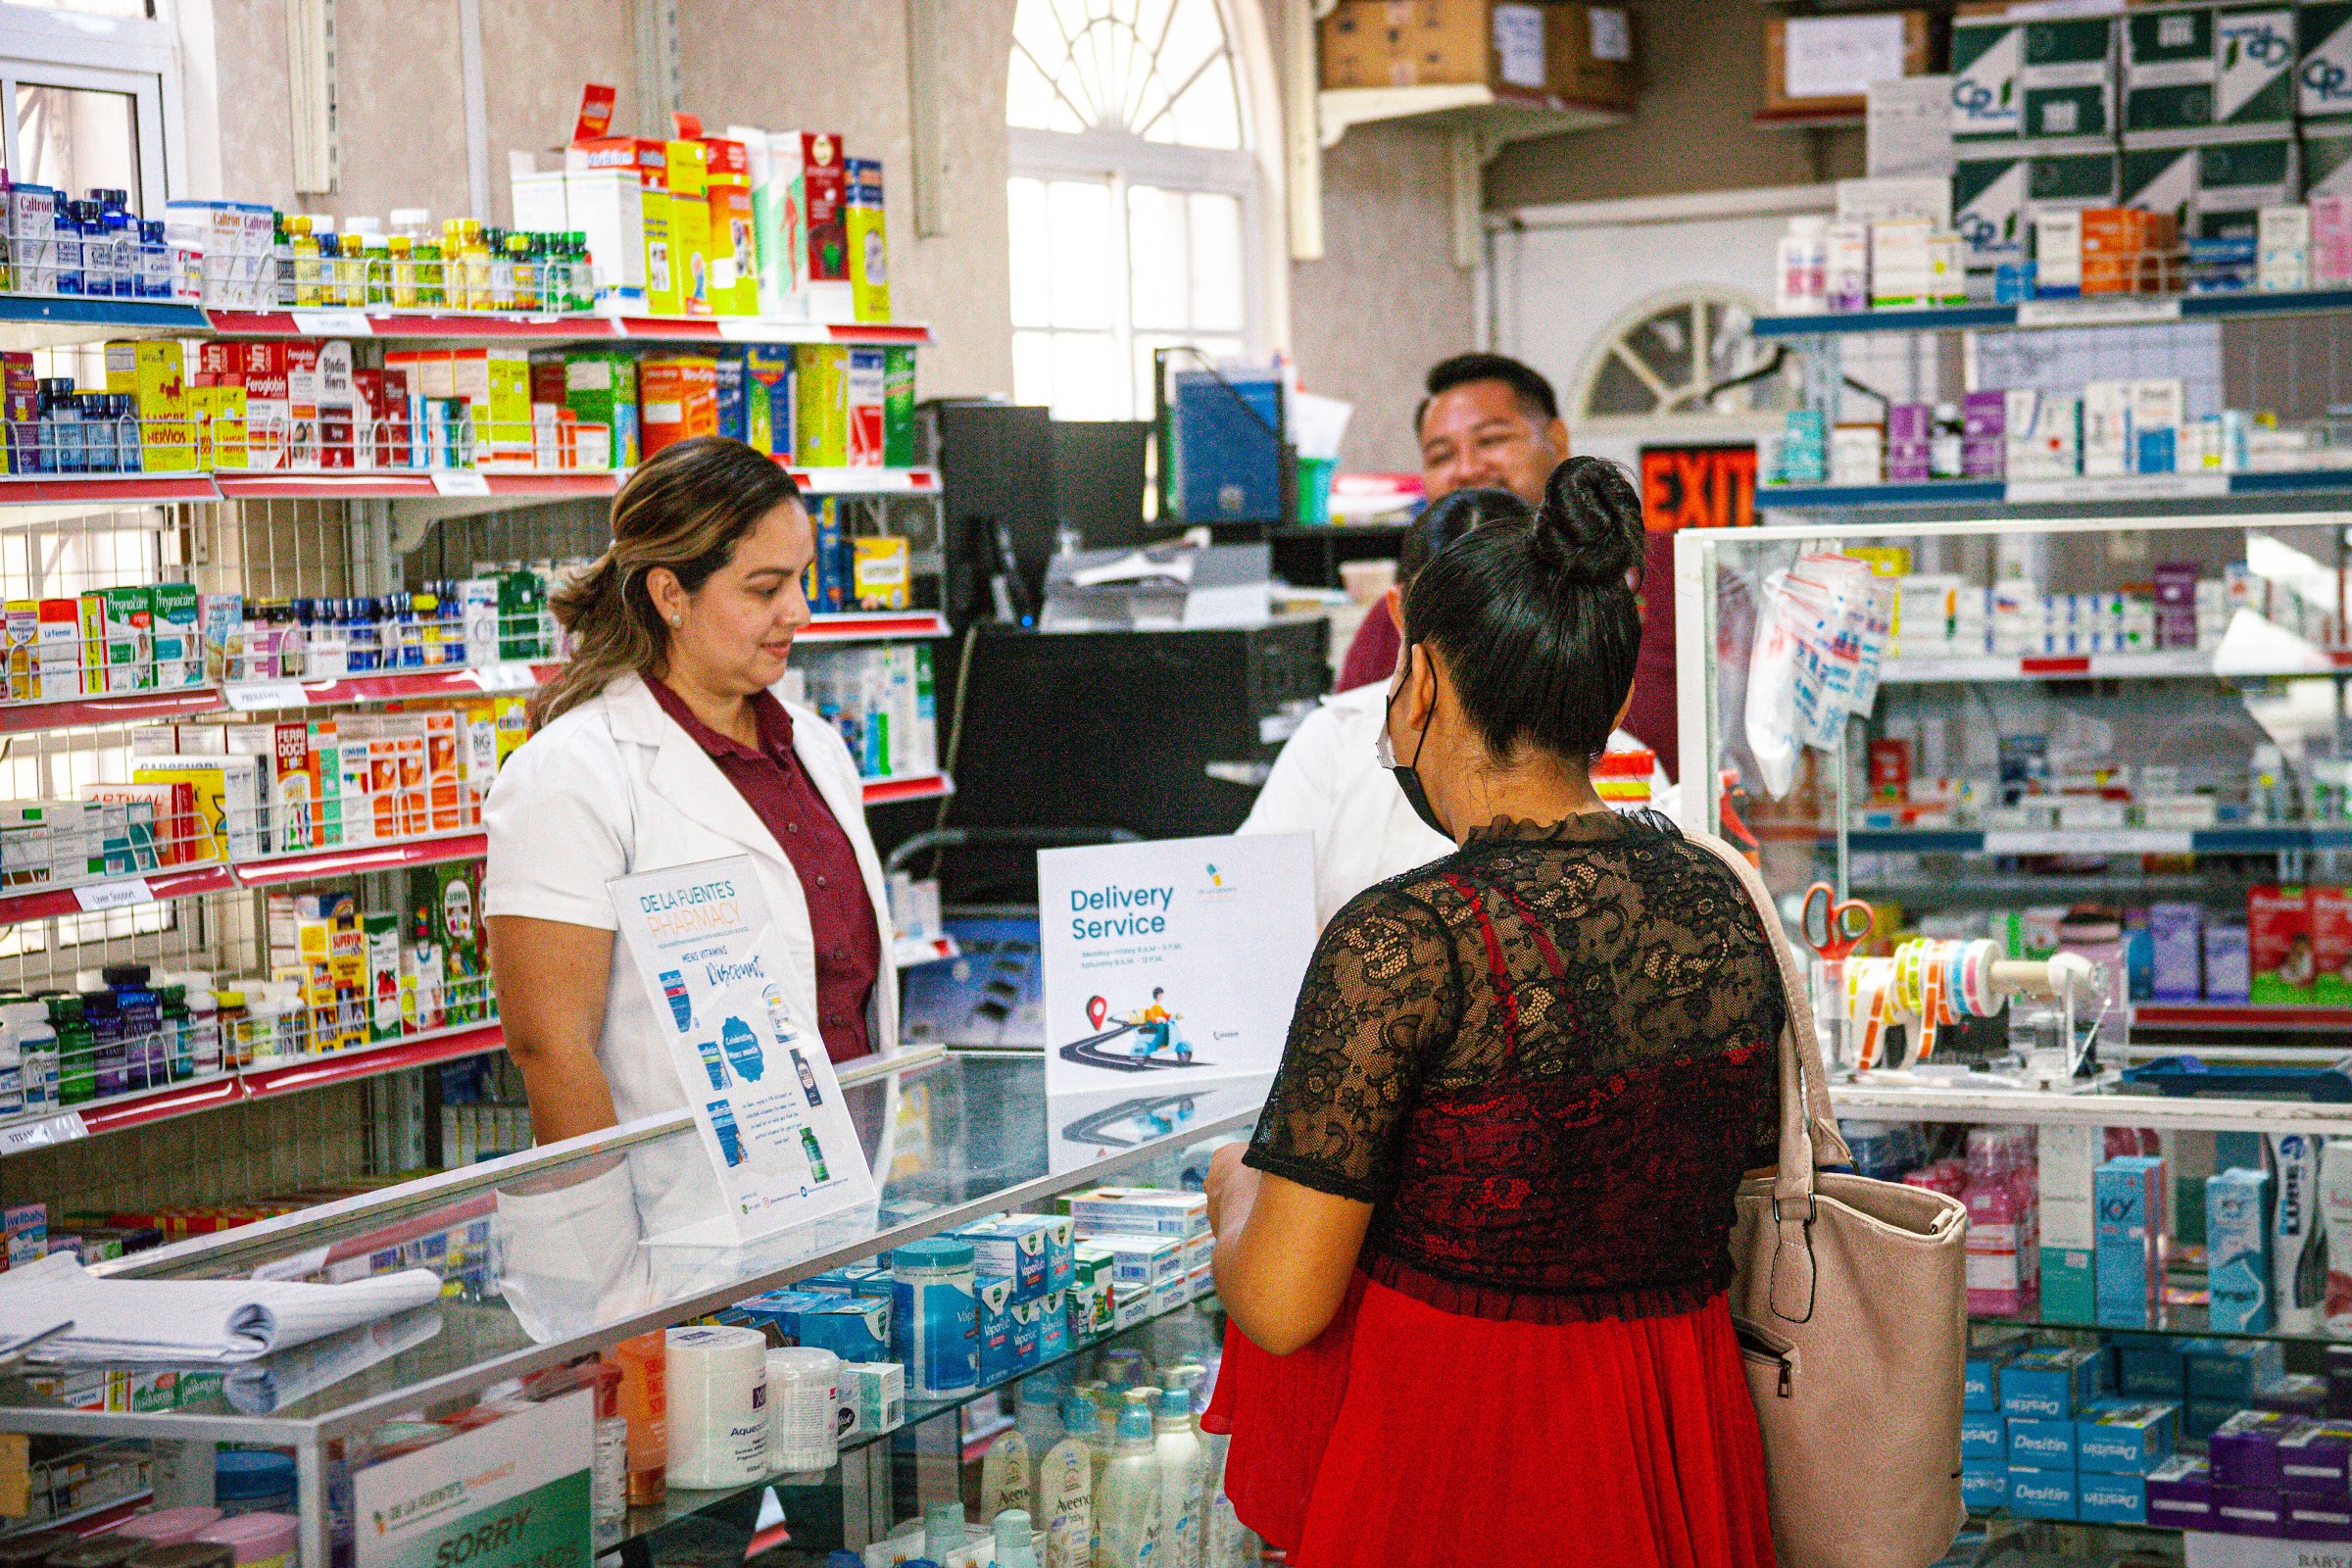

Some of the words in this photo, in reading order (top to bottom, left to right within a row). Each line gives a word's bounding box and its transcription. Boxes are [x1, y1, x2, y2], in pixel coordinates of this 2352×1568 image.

[245, 375, 286, 396] Feroglobin
[146, 427, 186, 444] NERVIOS
[1641, 450, 1756, 530] EXIT
[107, 591, 148, 613] Pregnacare
[155, 589, 196, 612] Pregnacare
[278, 743, 307, 758] DOCE
[640, 894, 661, 913] DE
[659, 891, 678, 910] LA
[677, 880, 736, 906] FUENTE'S
[1070, 884, 1174, 912] Delivery
[646, 900, 743, 938] PHARMACY
[1072, 911, 1166, 941] Service
[681, 951, 700, 963] MENS
[701, 945, 728, 960] VITAMINS
[705, 955, 764, 988] Discount
[2014, 1432, 2069, 1455] Desitin
[2082, 1442, 2137, 1461] Desitin
[2015, 1483, 2071, 1504] Desitin
[437, 1507, 533, 1567] SORRY
